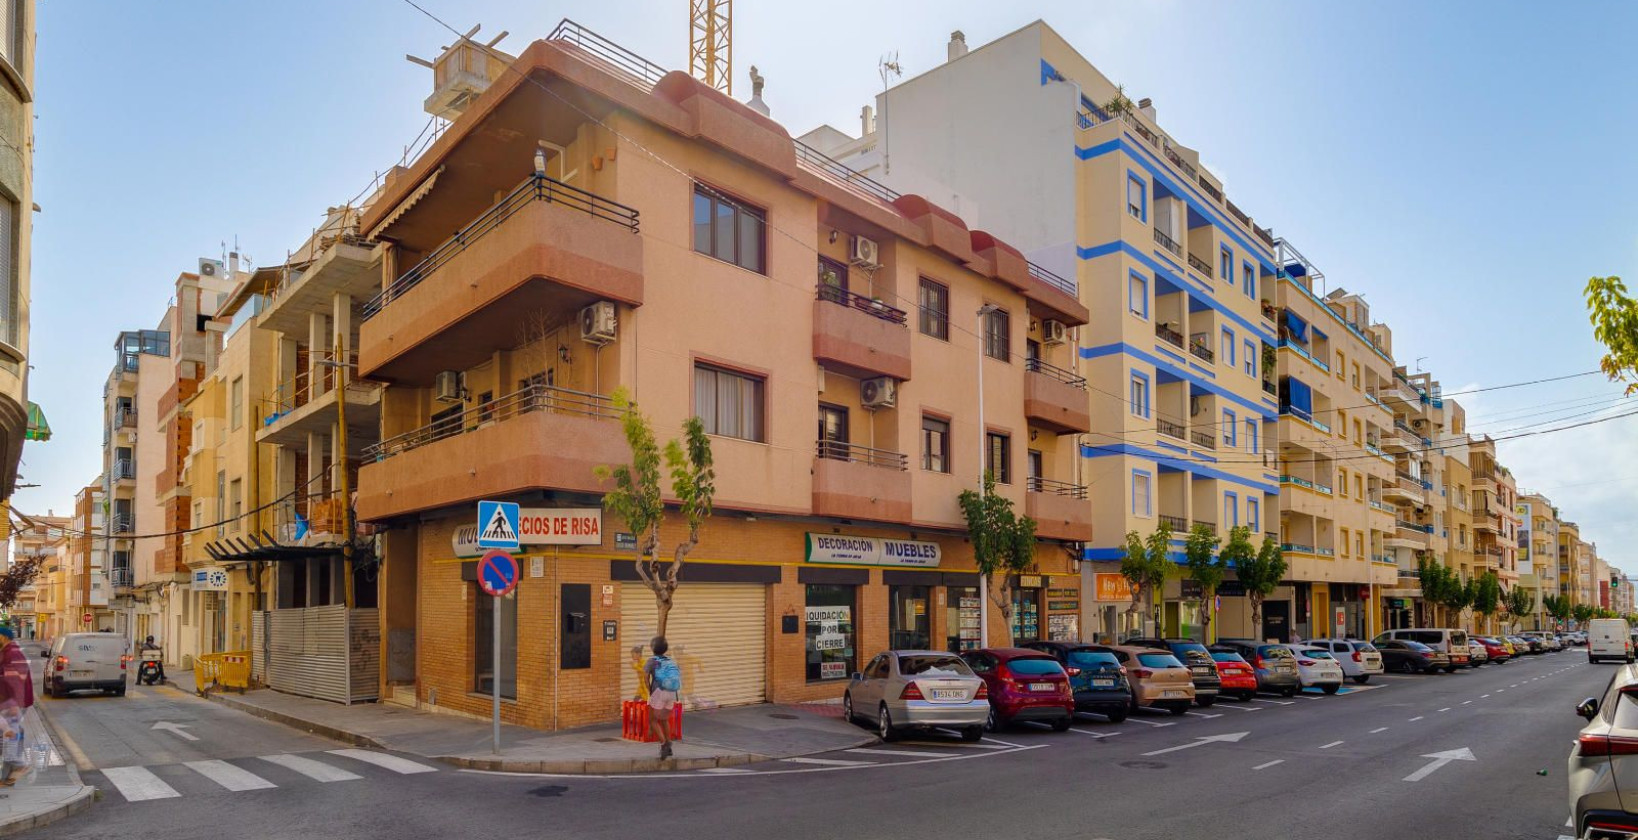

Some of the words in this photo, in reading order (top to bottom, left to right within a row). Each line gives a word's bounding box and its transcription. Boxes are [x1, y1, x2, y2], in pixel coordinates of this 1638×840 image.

[519, 517, 549, 535] CIOS
[553, 517, 568, 535] DE
[571, 517, 599, 535] RISA
[818, 537, 873, 552] DECORACIÓN
[885, 541, 937, 558] MUEBLES
[821, 625, 838, 634] POR
[816, 639, 844, 649] CIERRE
